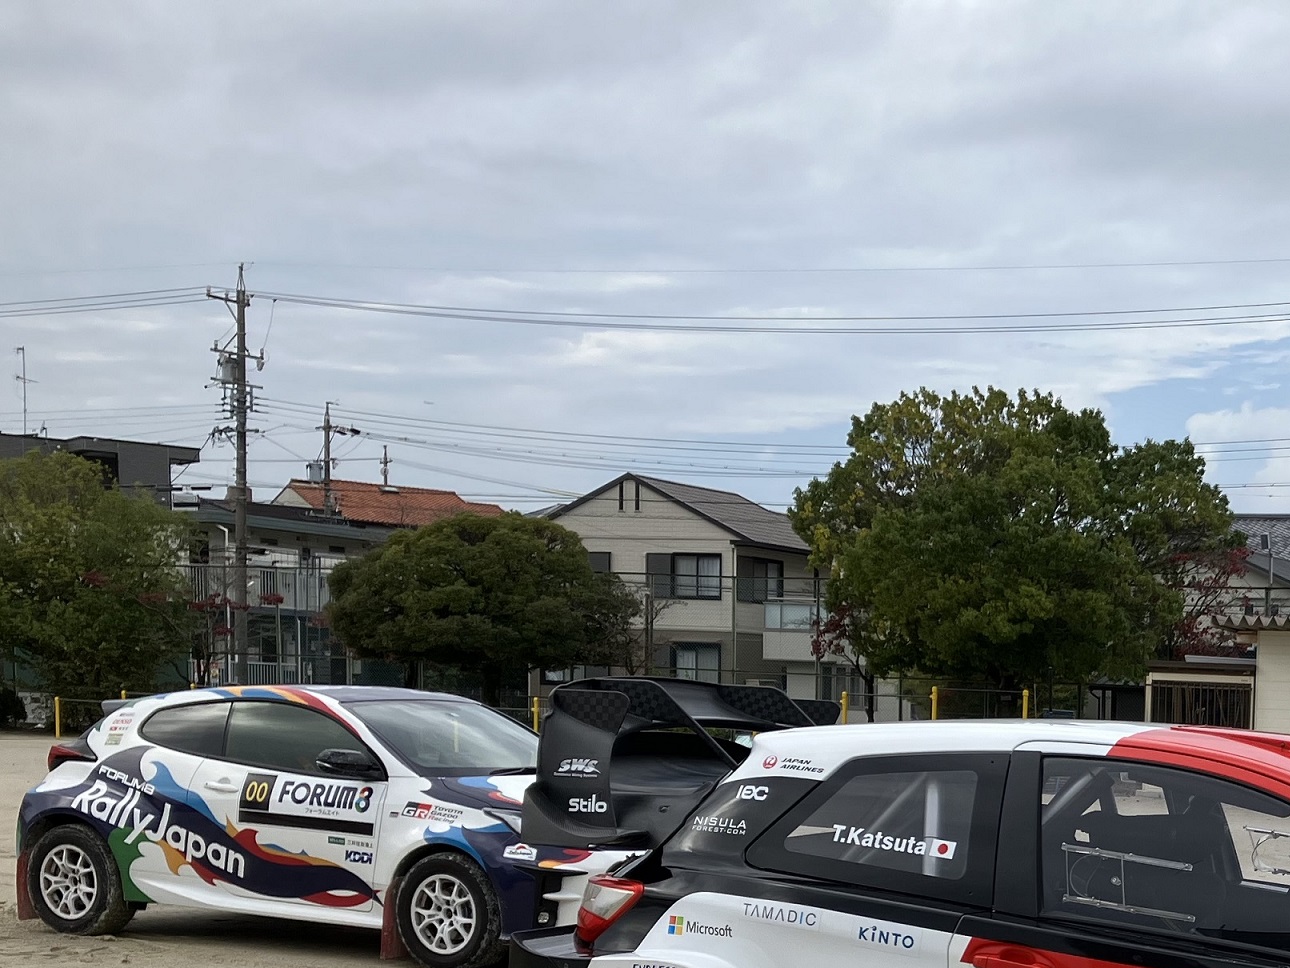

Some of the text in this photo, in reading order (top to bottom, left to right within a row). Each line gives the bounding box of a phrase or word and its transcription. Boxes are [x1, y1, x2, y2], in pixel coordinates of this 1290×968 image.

[558, 758, 601, 774] SWS
[780, 764, 825, 773] AIRLINES
[246, 781, 373, 813] 00 FORUM8
[568, 794, 607, 812] Stilo
[402, 807, 430, 819] GR
[434, 805, 463, 814] TOYOTA
[693, 816, 746, 829] NISULA
[832, 824, 927, 855] T.Katsuta
[345, 850, 373, 865] KDDI
[743, 903, 817, 926] TAMADIC
[686, 921, 733, 938] Microsoft
